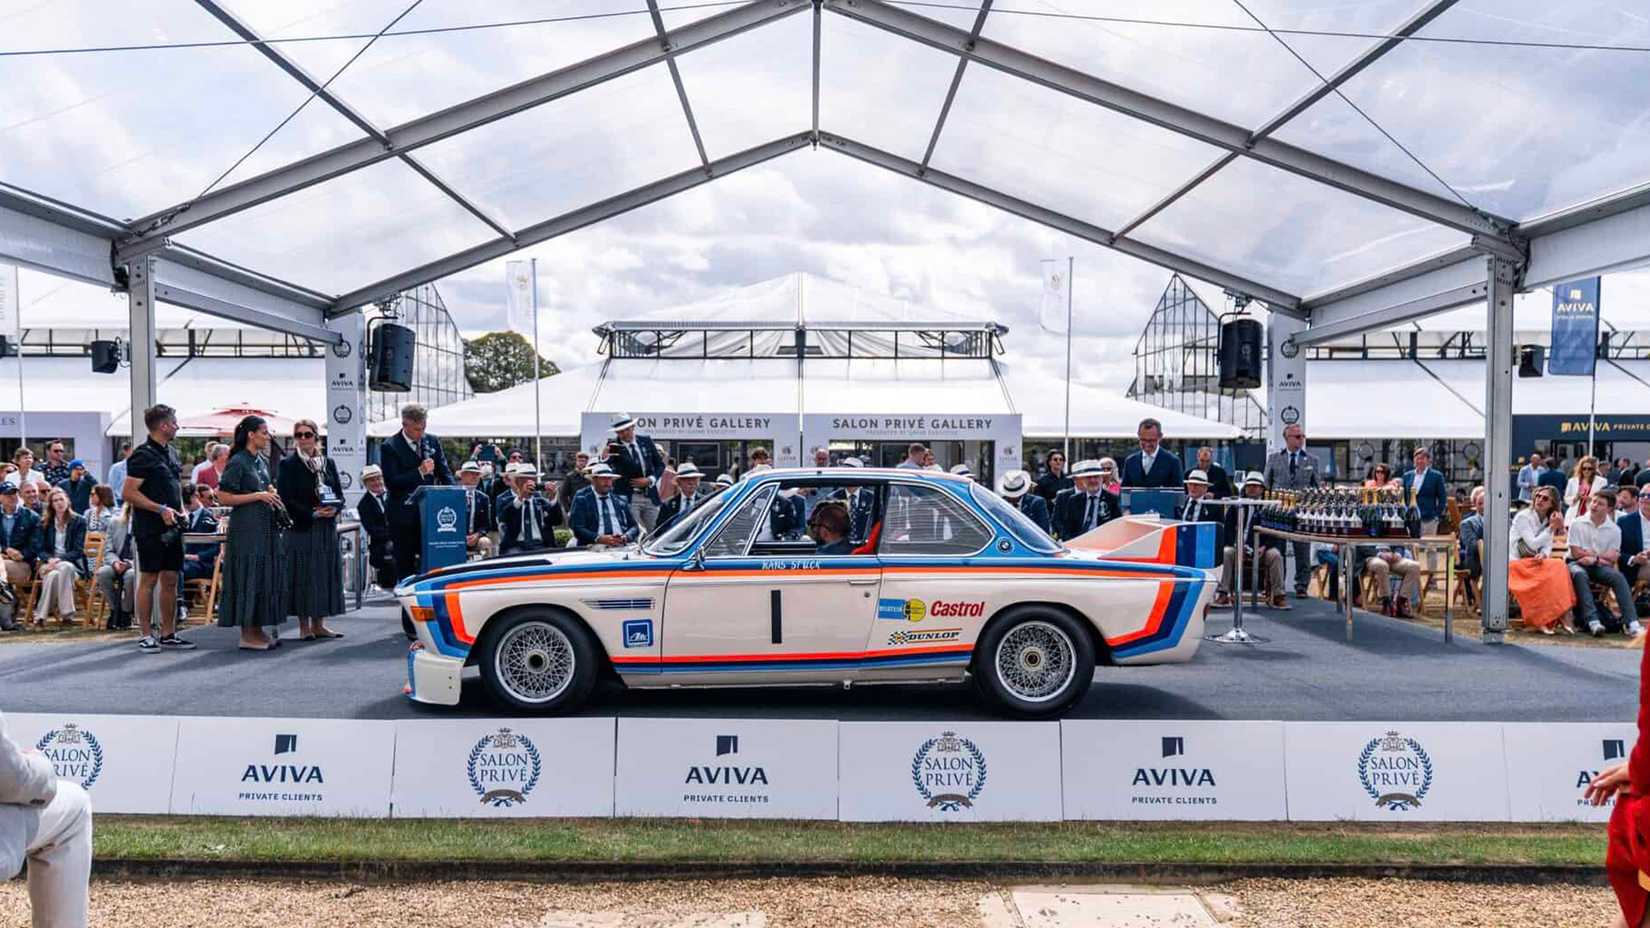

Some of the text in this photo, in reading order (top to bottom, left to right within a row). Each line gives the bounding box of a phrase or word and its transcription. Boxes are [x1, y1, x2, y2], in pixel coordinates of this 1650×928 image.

[1557, 303, 1594, 312] AVIVA
[664, 416, 702, 428] PRIVÉ
[709, 418, 771, 429] GALLERY
[833, 417, 992, 429] SALON PRIVÉ GALLERY
[1573, 422, 1610, 432] AVVA
[930, 601, 985, 617] Castrol
[908, 631, 960, 641] DUNLOP
[44, 748, 91, 762] SALON
[480, 753, 528, 767] SALON
[53, 762, 89, 777] RIVÉ
[925, 757, 973, 770] SALON
[1371, 756, 1419, 770] SALON
[241, 765, 324, 784] AVIVA
[480, 767, 528, 782] PRIVÉ
[684, 766, 769, 785] AVIVA
[926, 770, 973, 786] PRIVÉ
[1131, 768, 1216, 786] AVIVA
[1372, 770, 1420, 785] PRIVÉ
[239, 792, 323, 802] PRIVATE CLIENTS
[683, 794, 769, 804] PRIVATE CLIENTS
[1131, 796, 1218, 805] PRIVATE CLIENTS
